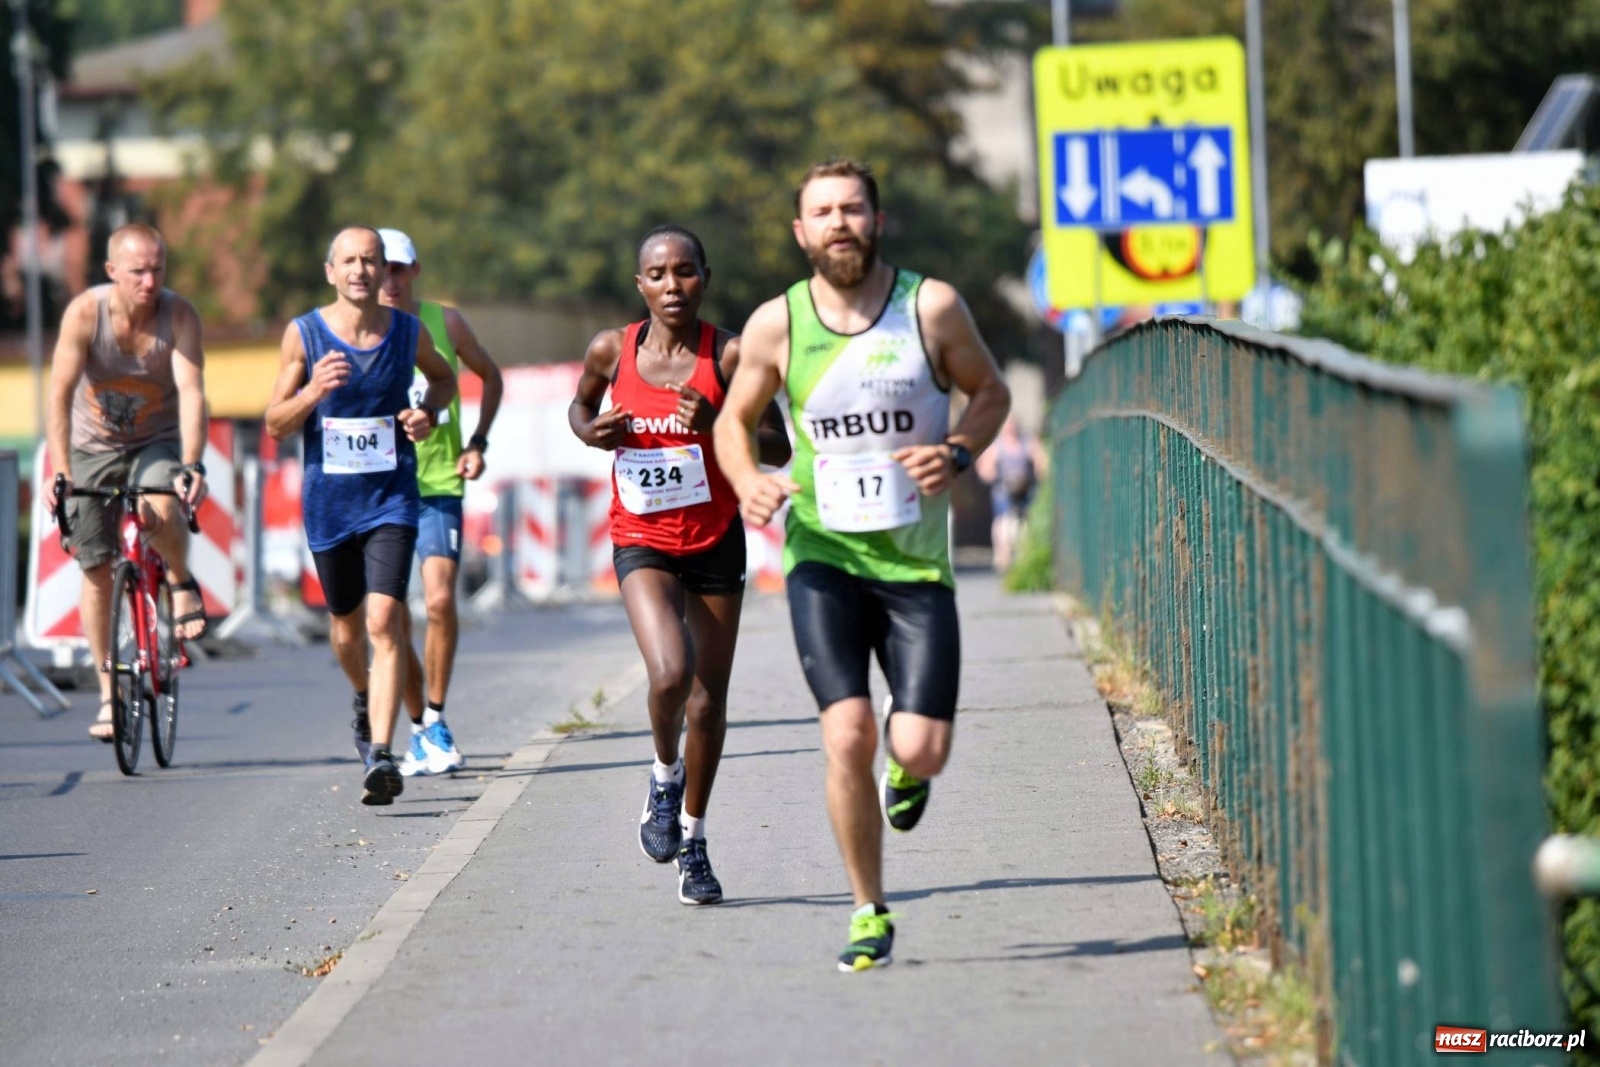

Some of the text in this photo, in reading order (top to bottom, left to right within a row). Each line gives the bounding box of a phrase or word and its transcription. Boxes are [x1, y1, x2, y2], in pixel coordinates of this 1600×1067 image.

[1057, 63, 1219, 106] Uwaga
[346, 433, 379, 451] 104
[638, 466, 683, 488] 234
[857, 475, 882, 498] 17
